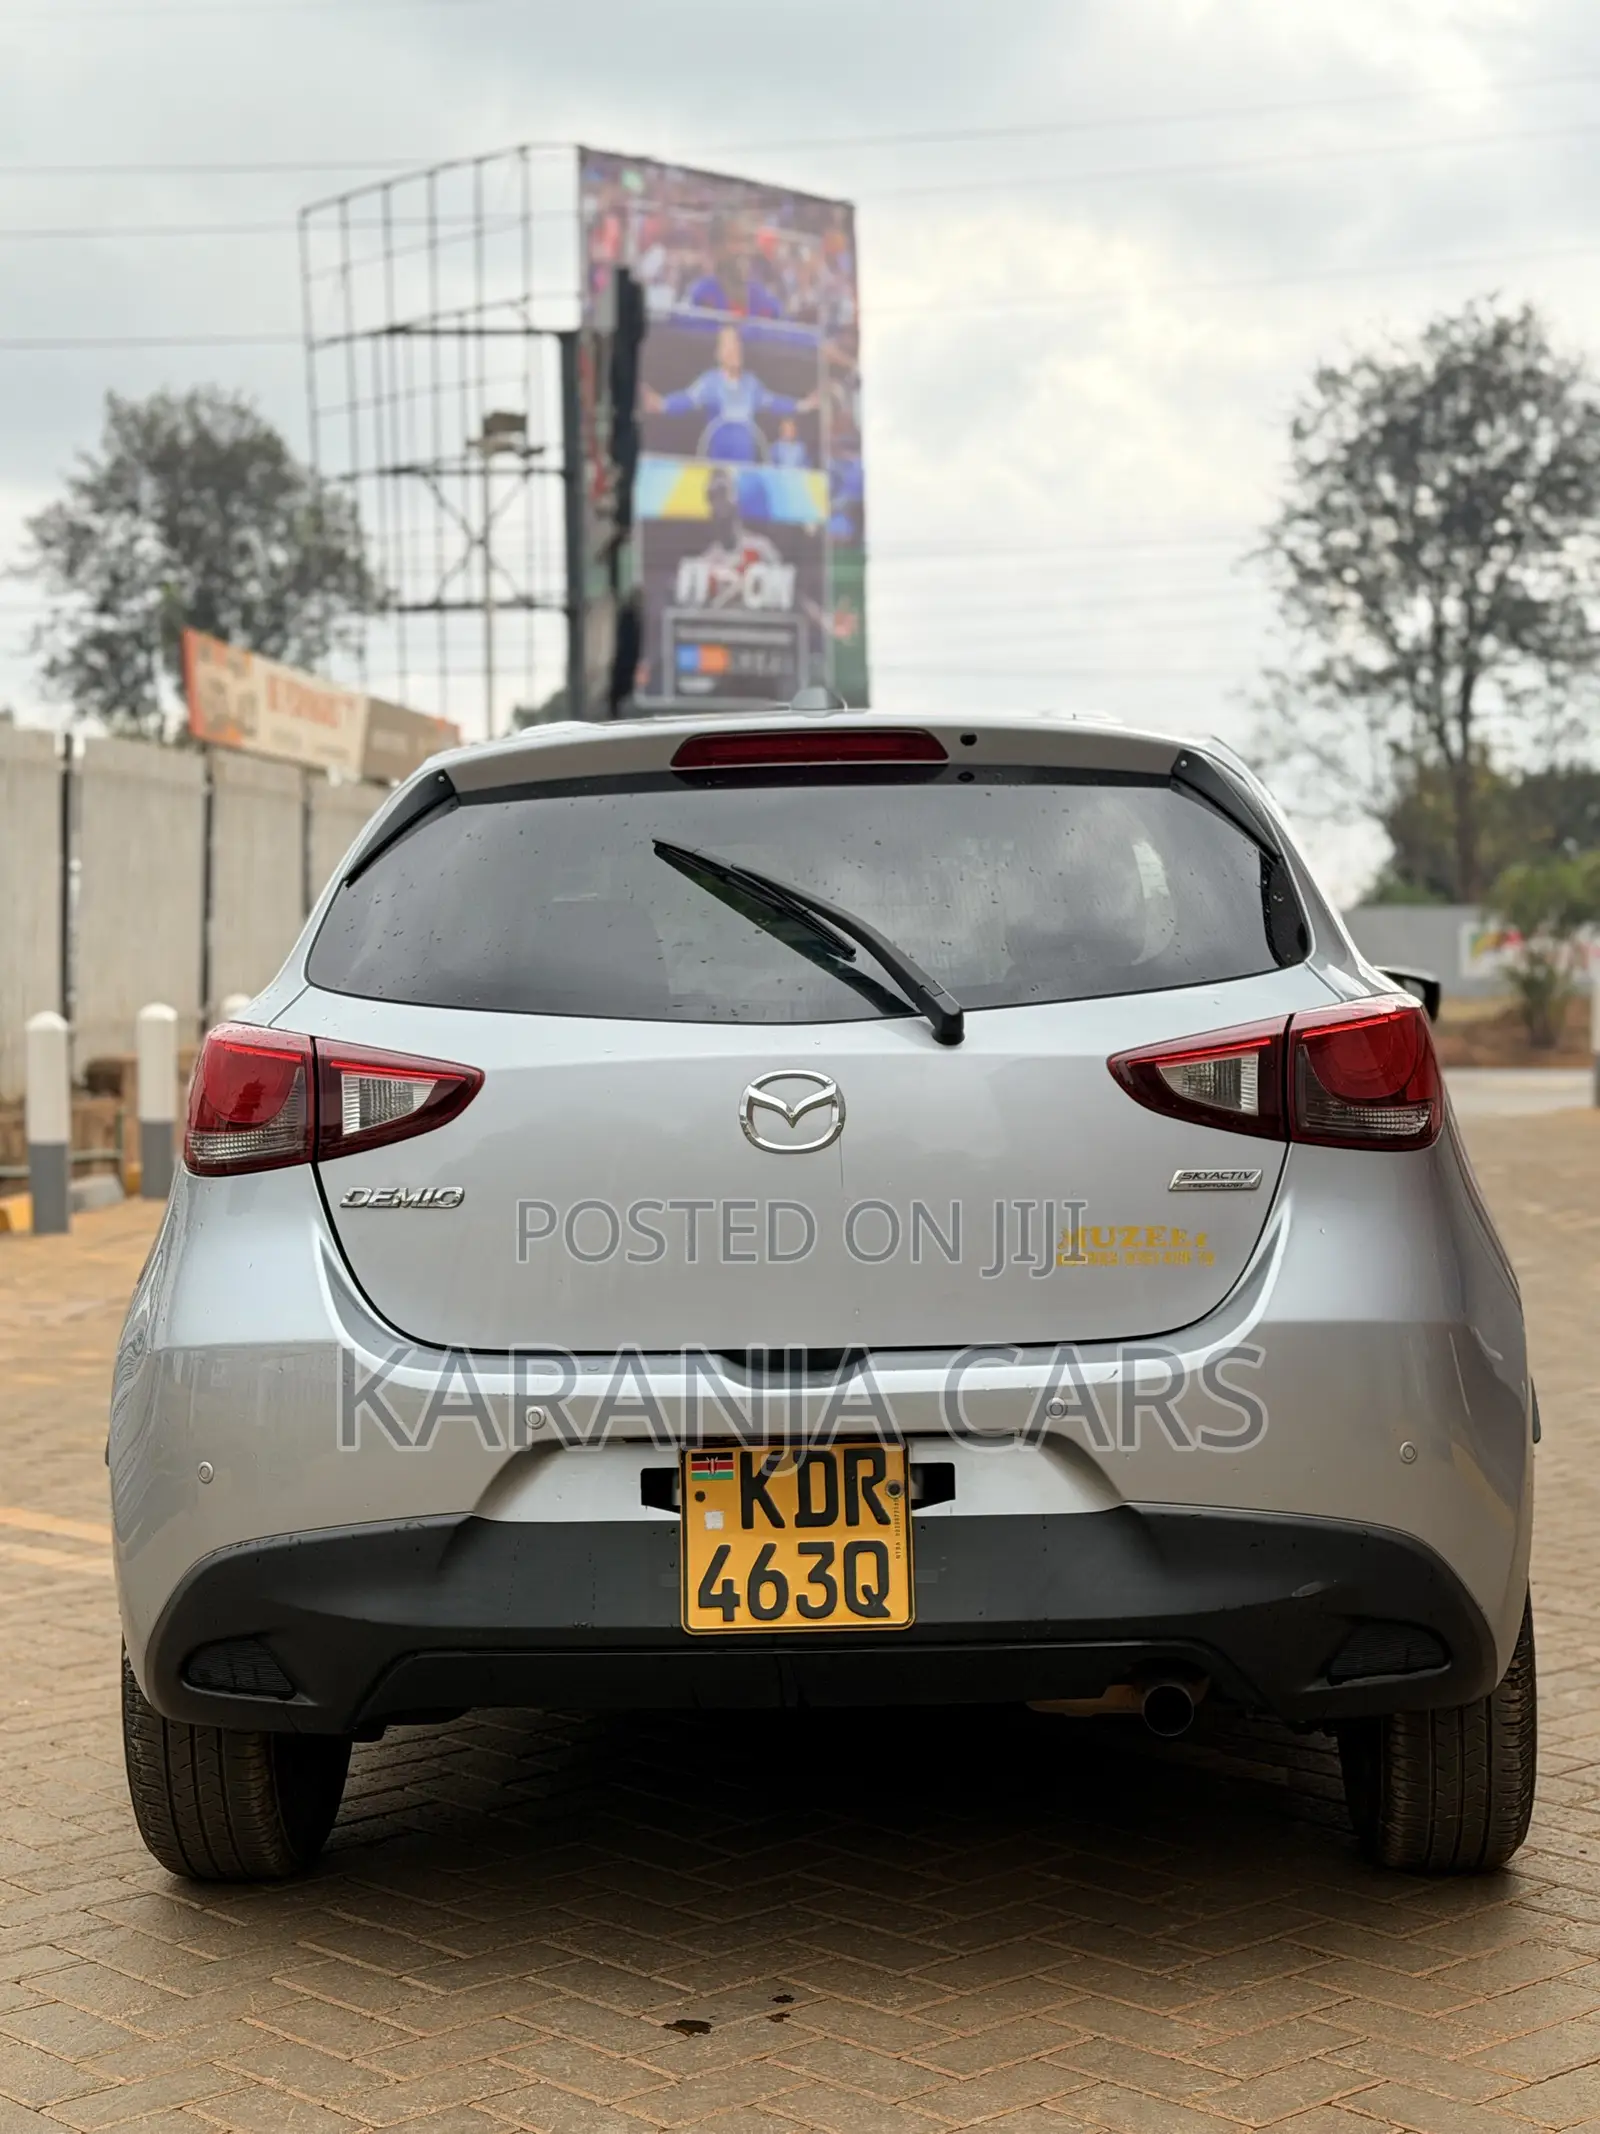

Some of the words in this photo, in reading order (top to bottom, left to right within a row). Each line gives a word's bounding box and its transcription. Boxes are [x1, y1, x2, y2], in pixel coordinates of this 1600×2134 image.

[340, 1187, 465, 1208] DEMIO
[1181, 1171, 1255, 1180] SKYACTIV
[740, 1448, 892, 1529] KDR
[698, 1540, 891, 1622] 463Q
